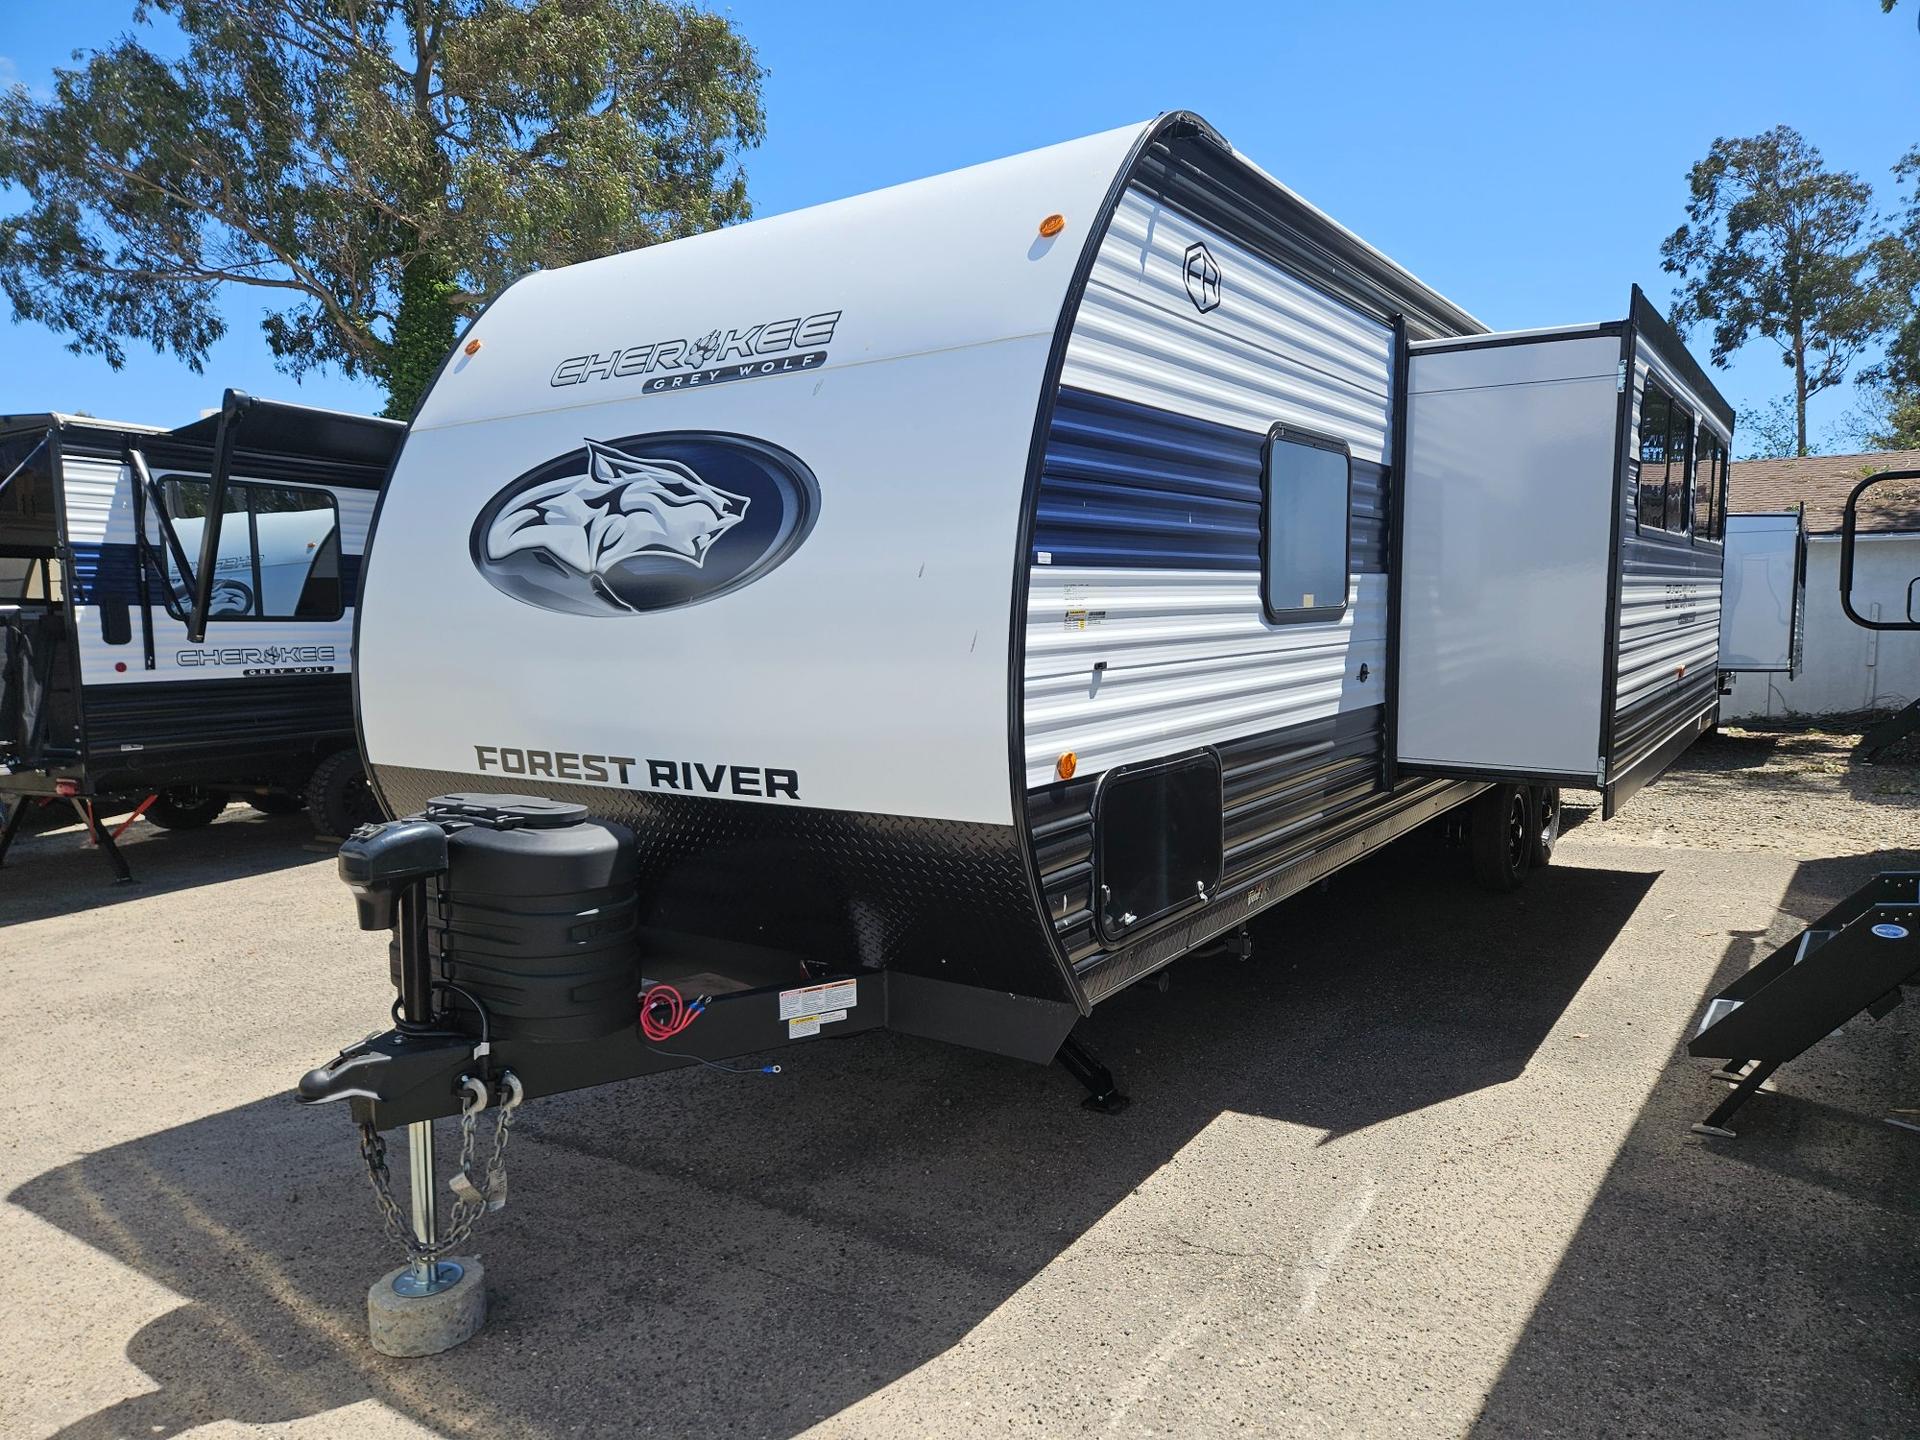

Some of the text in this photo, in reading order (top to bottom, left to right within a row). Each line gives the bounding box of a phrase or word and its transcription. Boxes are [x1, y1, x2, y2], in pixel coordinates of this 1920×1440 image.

[653, 354, 816, 390] GREY WOLF
[248, 668, 285, 676] GREY
[474, 745, 801, 800] FOREST RIVER
